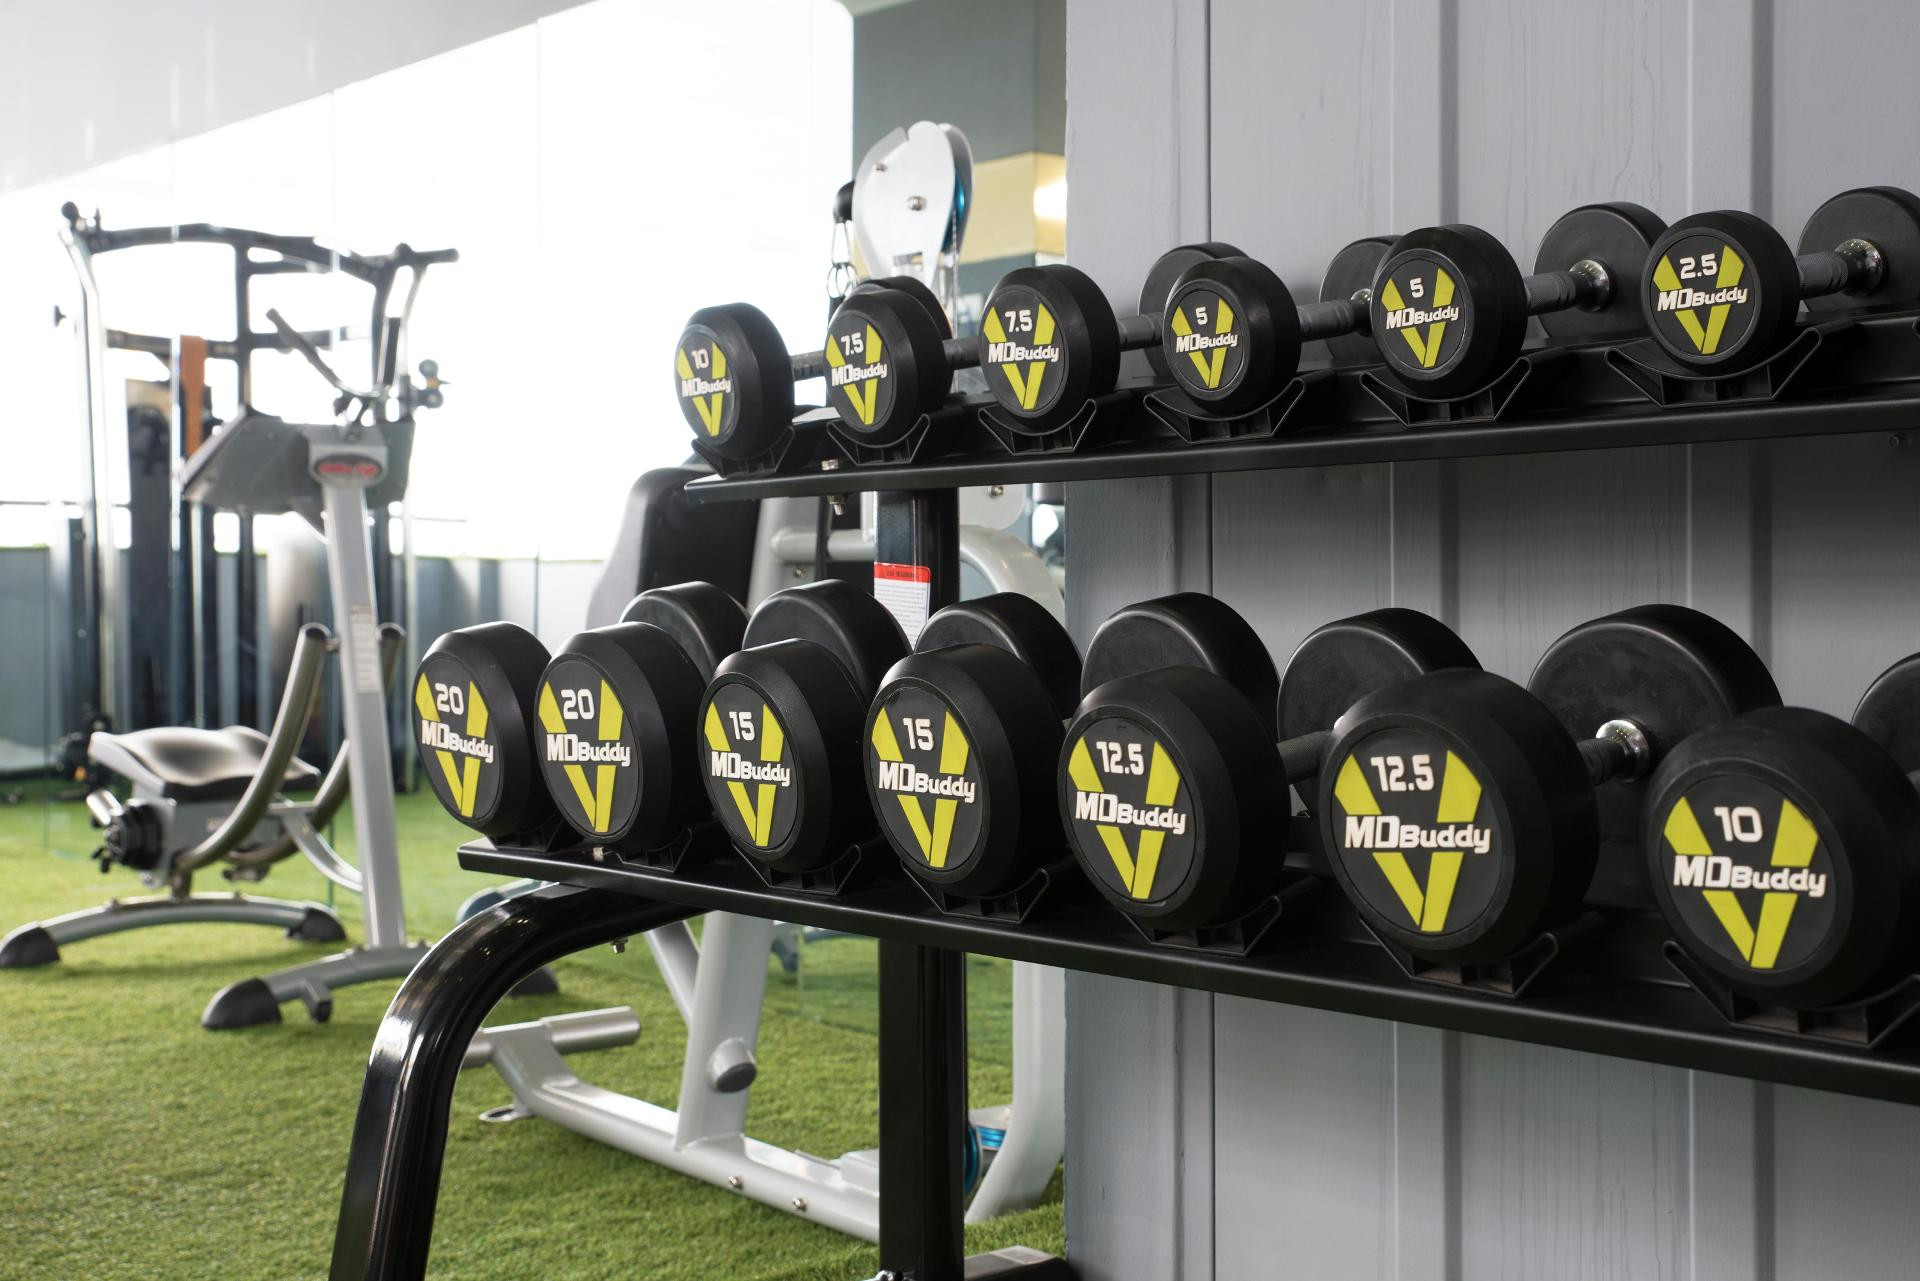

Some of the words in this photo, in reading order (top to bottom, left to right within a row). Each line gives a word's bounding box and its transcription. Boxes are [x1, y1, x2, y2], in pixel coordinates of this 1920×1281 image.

[1679, 252, 1718, 280] 2.5
[1409, 277, 1425, 299] 5
[1657, 286, 1749, 312] MDBuddy
[1004, 309, 1033, 333] 7.5
[1195, 306, 1209, 326] 5
[1385, 305, 1460, 330] MDBuddy
[691, 348, 708, 369] 10
[840, 331, 865, 357] 7.5
[987, 341, 1060, 365] MDBuddy
[1175, 332, 1239, 354] MDBuddy
[681, 375, 732, 398] MDBuddy
[831, 361, 889, 387] MDBuddy
[434, 682, 465, 716] 20
[560, 687, 596, 720] 20
[421, 718, 495, 764] MDBuddy
[728, 710, 756, 741] 15
[902, 717, 935, 751] 15
[546, 733, 631, 768] MDBuddy
[1095, 740, 1145, 776] 12.5
[711, 750, 791, 788] MDBuddy
[878, 760, 976, 804] MDBuddy
[1369, 753, 1435, 792] 12.5
[1075, 790, 1187, 835] MDBuddy
[1713, 806, 1763, 843] 10
[1344, 815, 1491, 854] MDBuddy
[1673, 854, 1827, 898] MDBuddy
